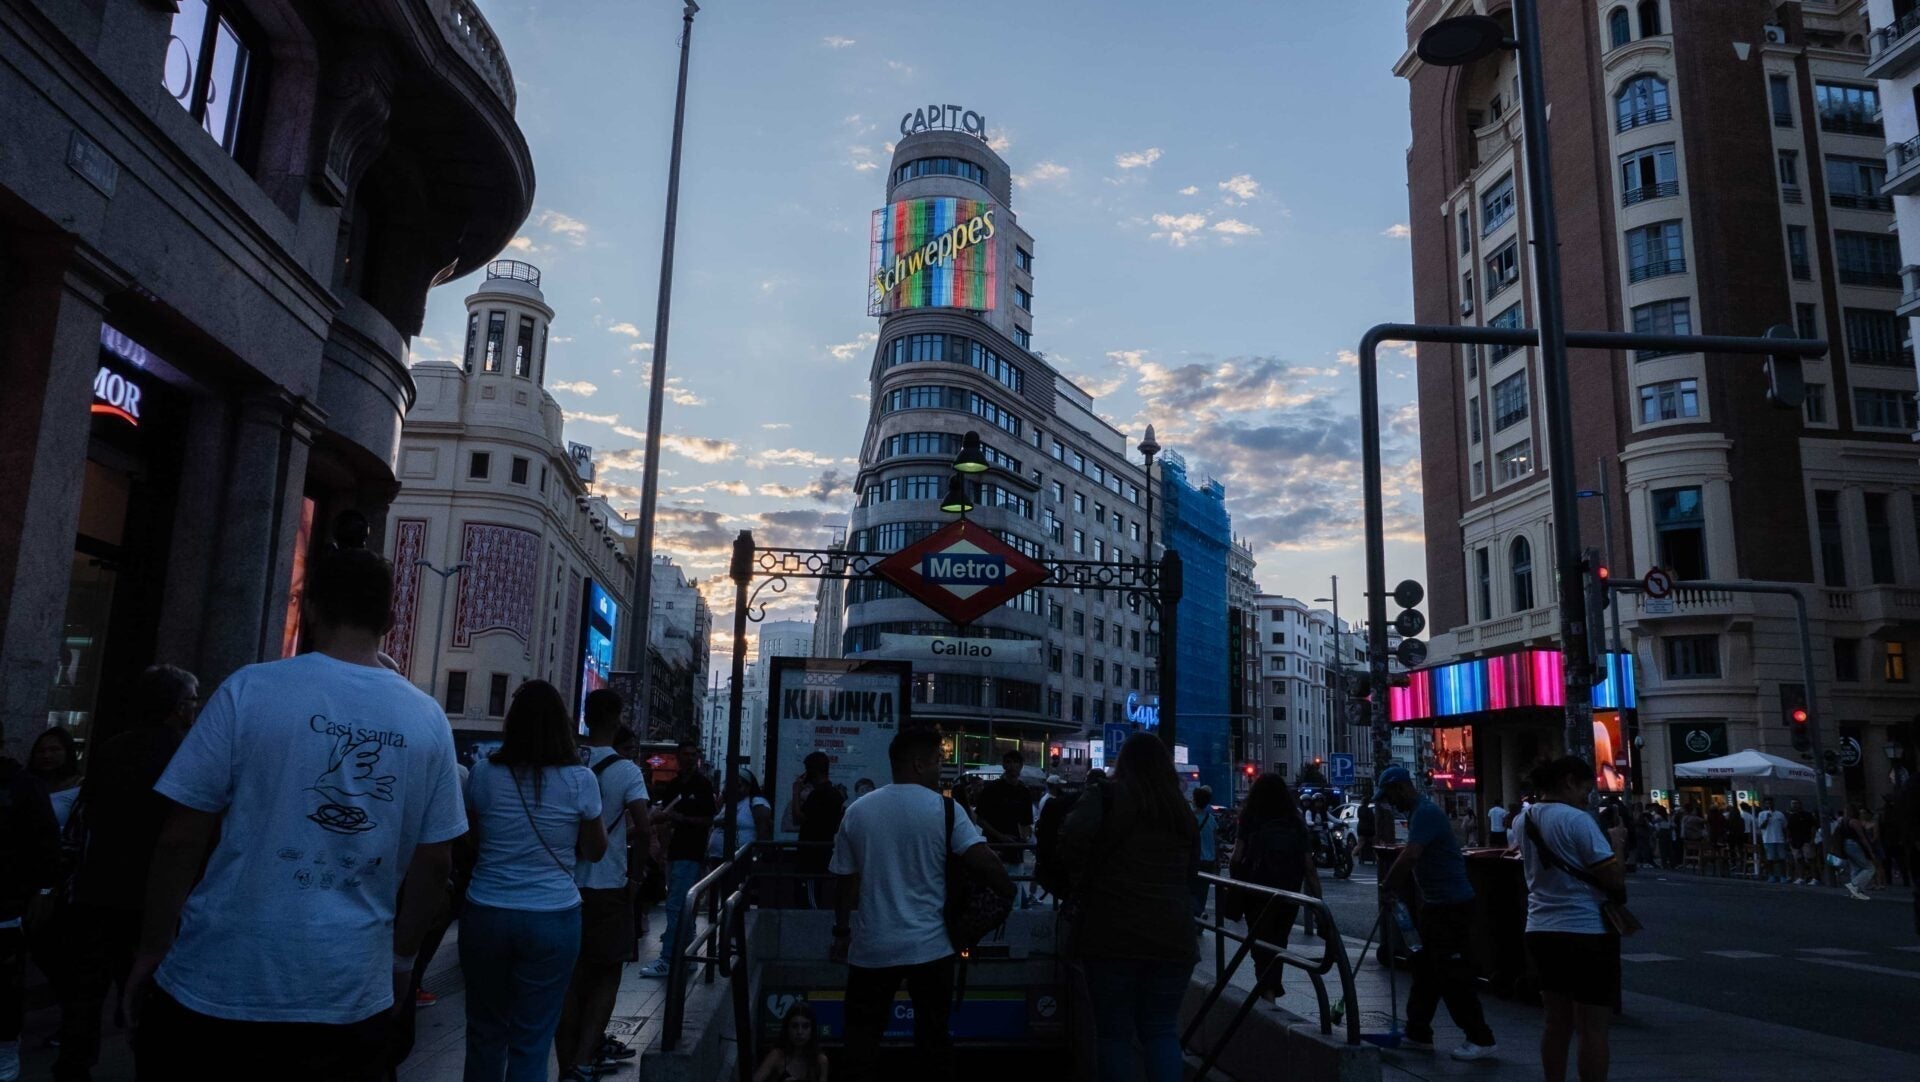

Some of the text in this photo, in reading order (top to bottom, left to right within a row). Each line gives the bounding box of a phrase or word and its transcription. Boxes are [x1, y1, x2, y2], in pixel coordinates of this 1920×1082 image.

[900, 104, 988, 141] CAPITOL
[875, 210, 995, 304] Schweppes
[930, 557, 1000, 579] Metro
[931, 640, 992, 657] Callao
[1232, 624, 1240, 689] HOTEL
[783, 688, 894, 722] KULUNKA
[310, 714, 407, 748] Casi santa.
[1111, 729, 1125, 752] P
[1335, 757, 1352, 778] P
